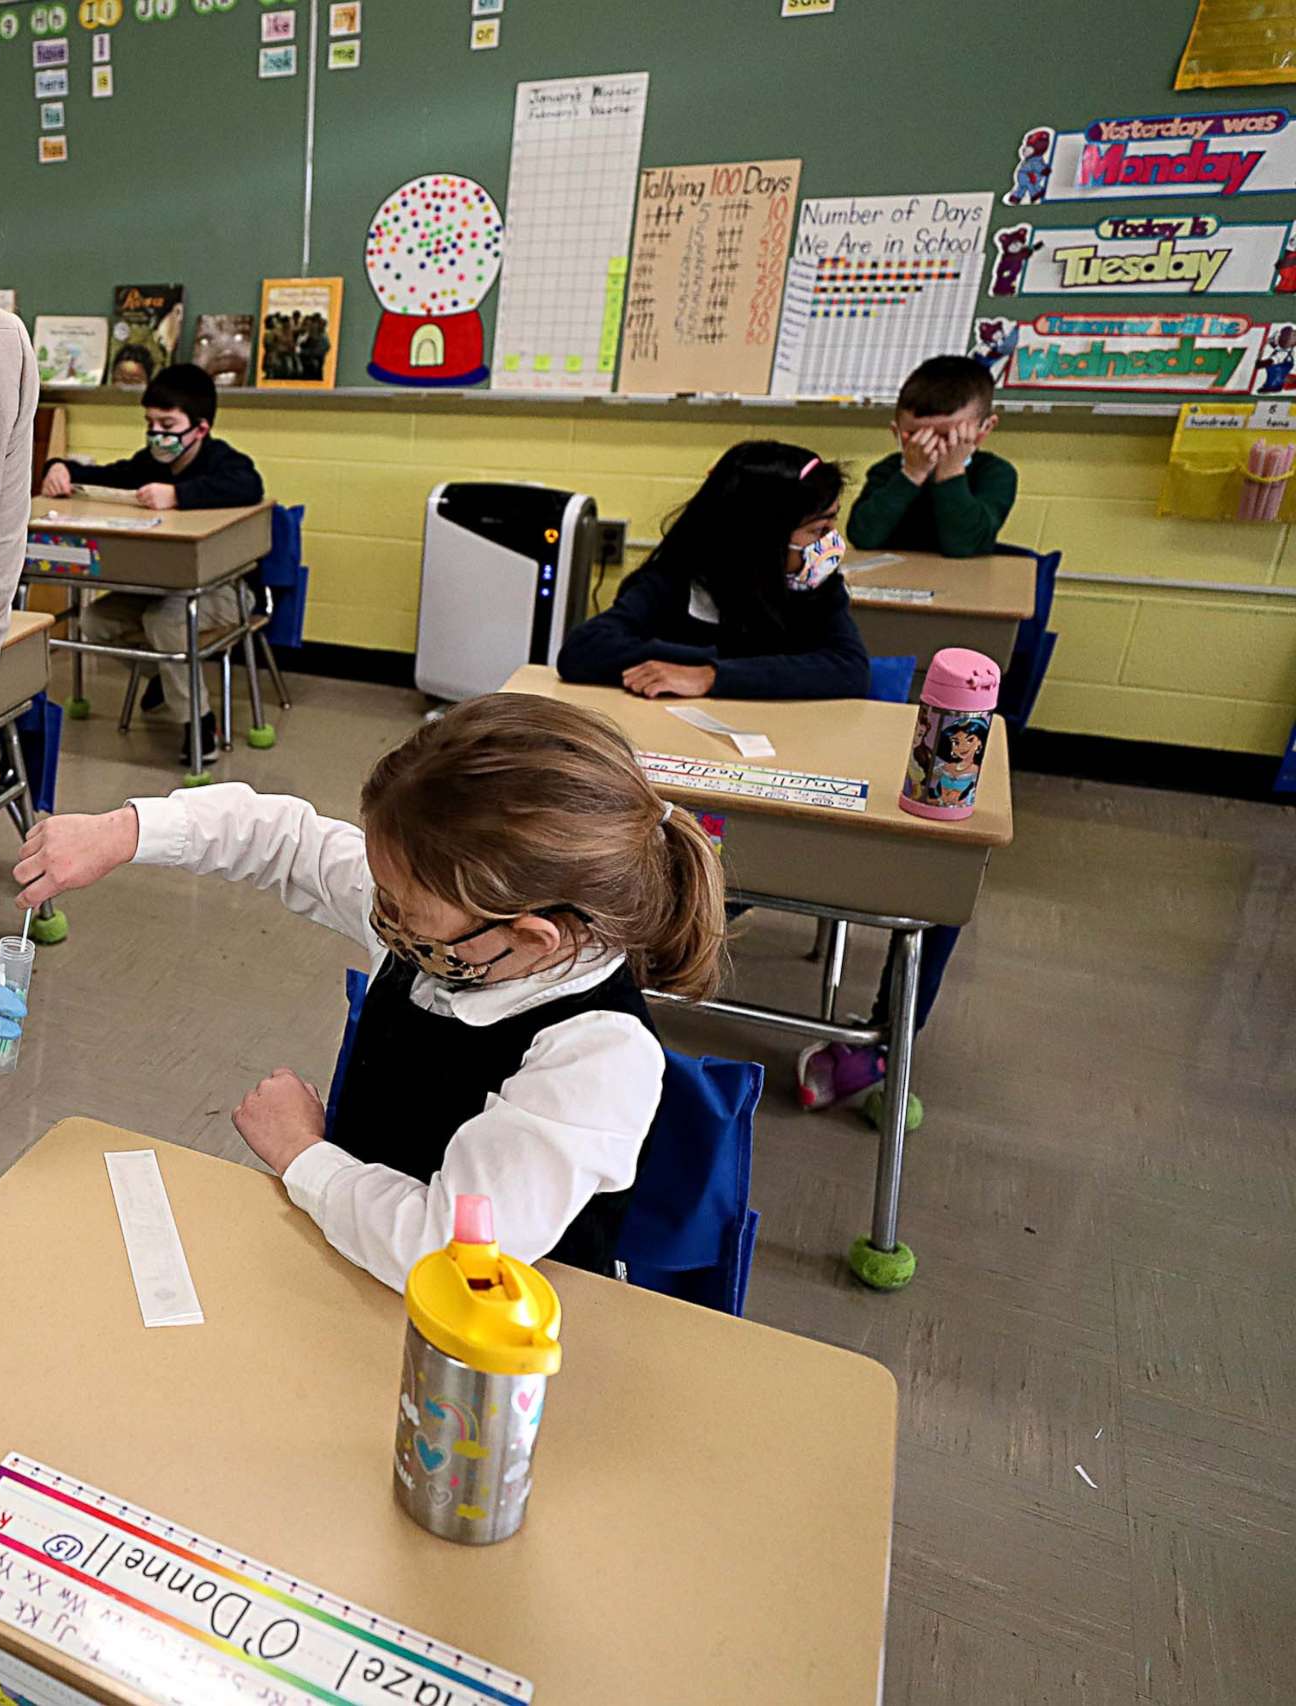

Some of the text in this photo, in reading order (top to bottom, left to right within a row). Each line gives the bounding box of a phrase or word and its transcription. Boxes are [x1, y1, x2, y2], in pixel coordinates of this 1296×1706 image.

[475, 27, 495, 42] or
[1098, 113, 1279, 142] Yesterday was
[1080, 140, 1266, 196] Monday
[642, 166, 793, 206] Tallying 100 Days
[768, 195, 789, 221] 10
[802, 199, 983, 229] Number of Days
[798, 226, 982, 255] We Are in School
[1107, 218, 1185, 239] Today
[1054, 238, 1232, 293] Tuesday
[1045, 316, 1242, 335] Tomorrow will be
[1016, 336, 1248, 388] Wednesday
[1190, 417, 1239, 428] hundreds
[1266, 417, 1290, 428] tens
[675, 761, 745, 782] Reddy
[772, 777, 849, 794] Anjali
[23, 1569, 50, 1596] Xx
[80, 1533, 300, 1659] O'Donnell
[13, 1599, 40, 1628] Kk
[58, 1588, 87, 1617] Ww
[48, 1614, 78, 1642] Jj
